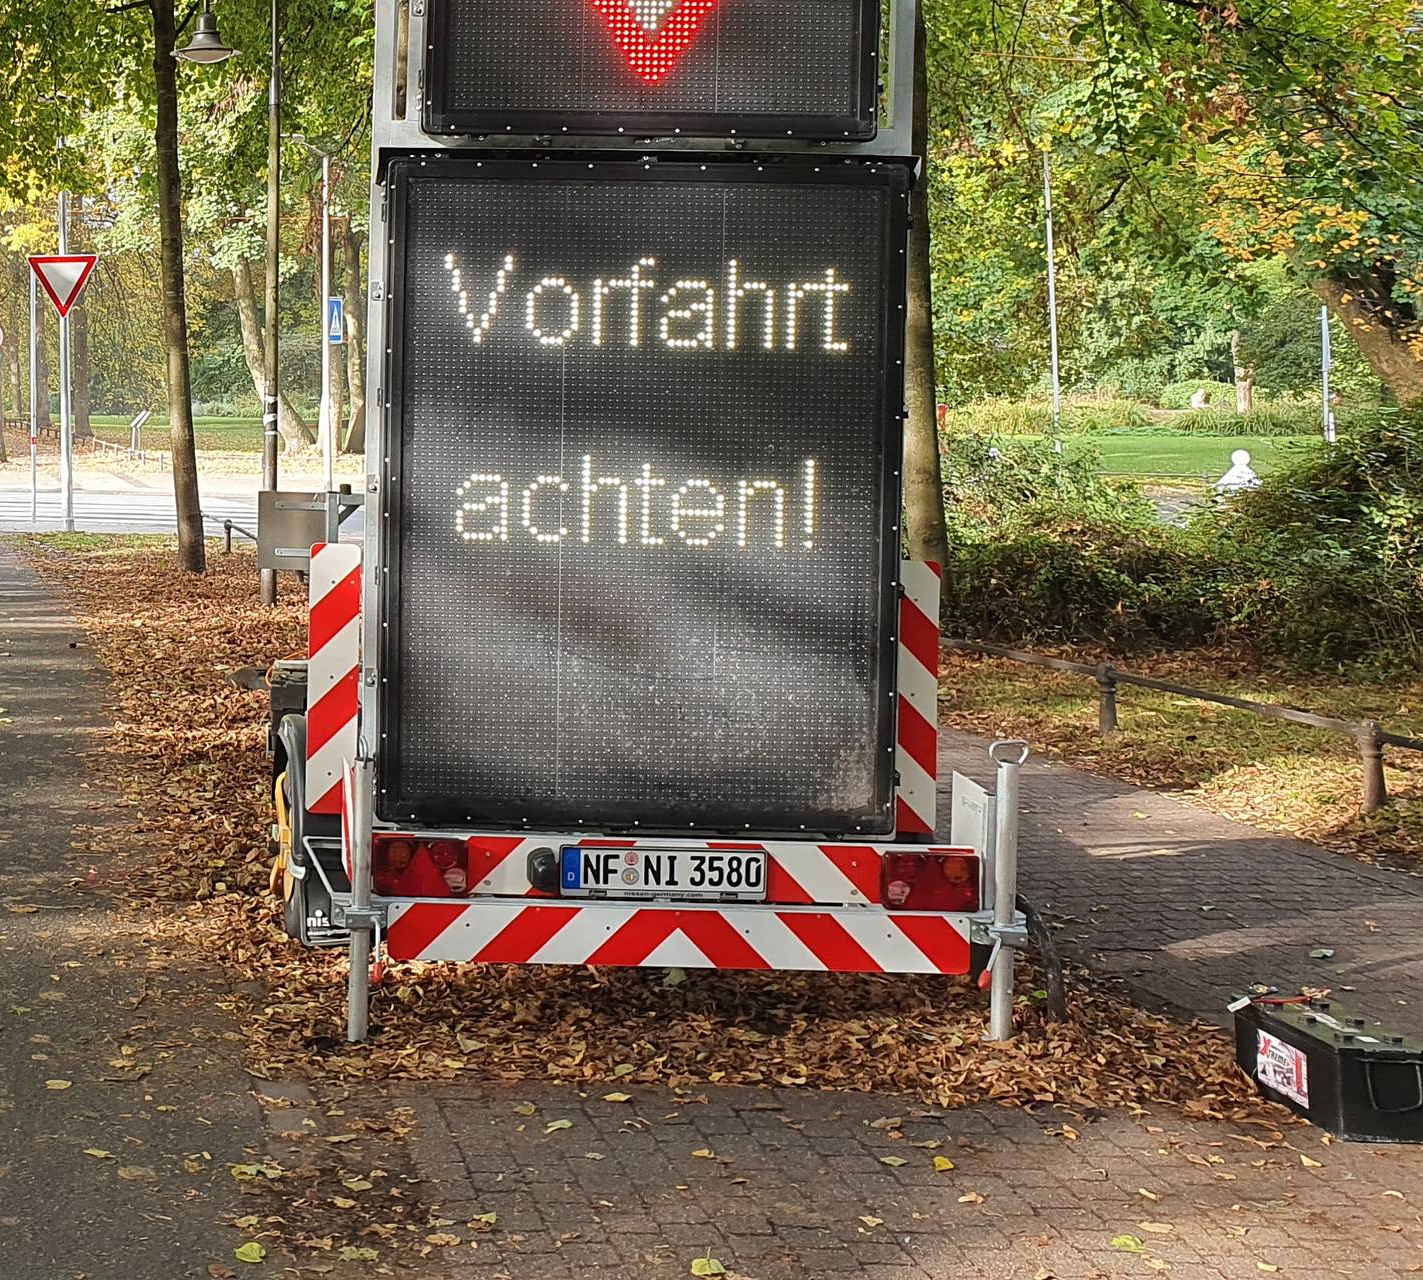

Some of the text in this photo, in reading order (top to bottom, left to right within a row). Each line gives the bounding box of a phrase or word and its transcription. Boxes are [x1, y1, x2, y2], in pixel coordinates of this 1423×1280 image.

[444, 252, 851, 350] Vorfahrt
[455, 453, 818, 549] achten!
[567, 871, 575, 881] D
[582, 853, 762, 888] NF NI 3580
